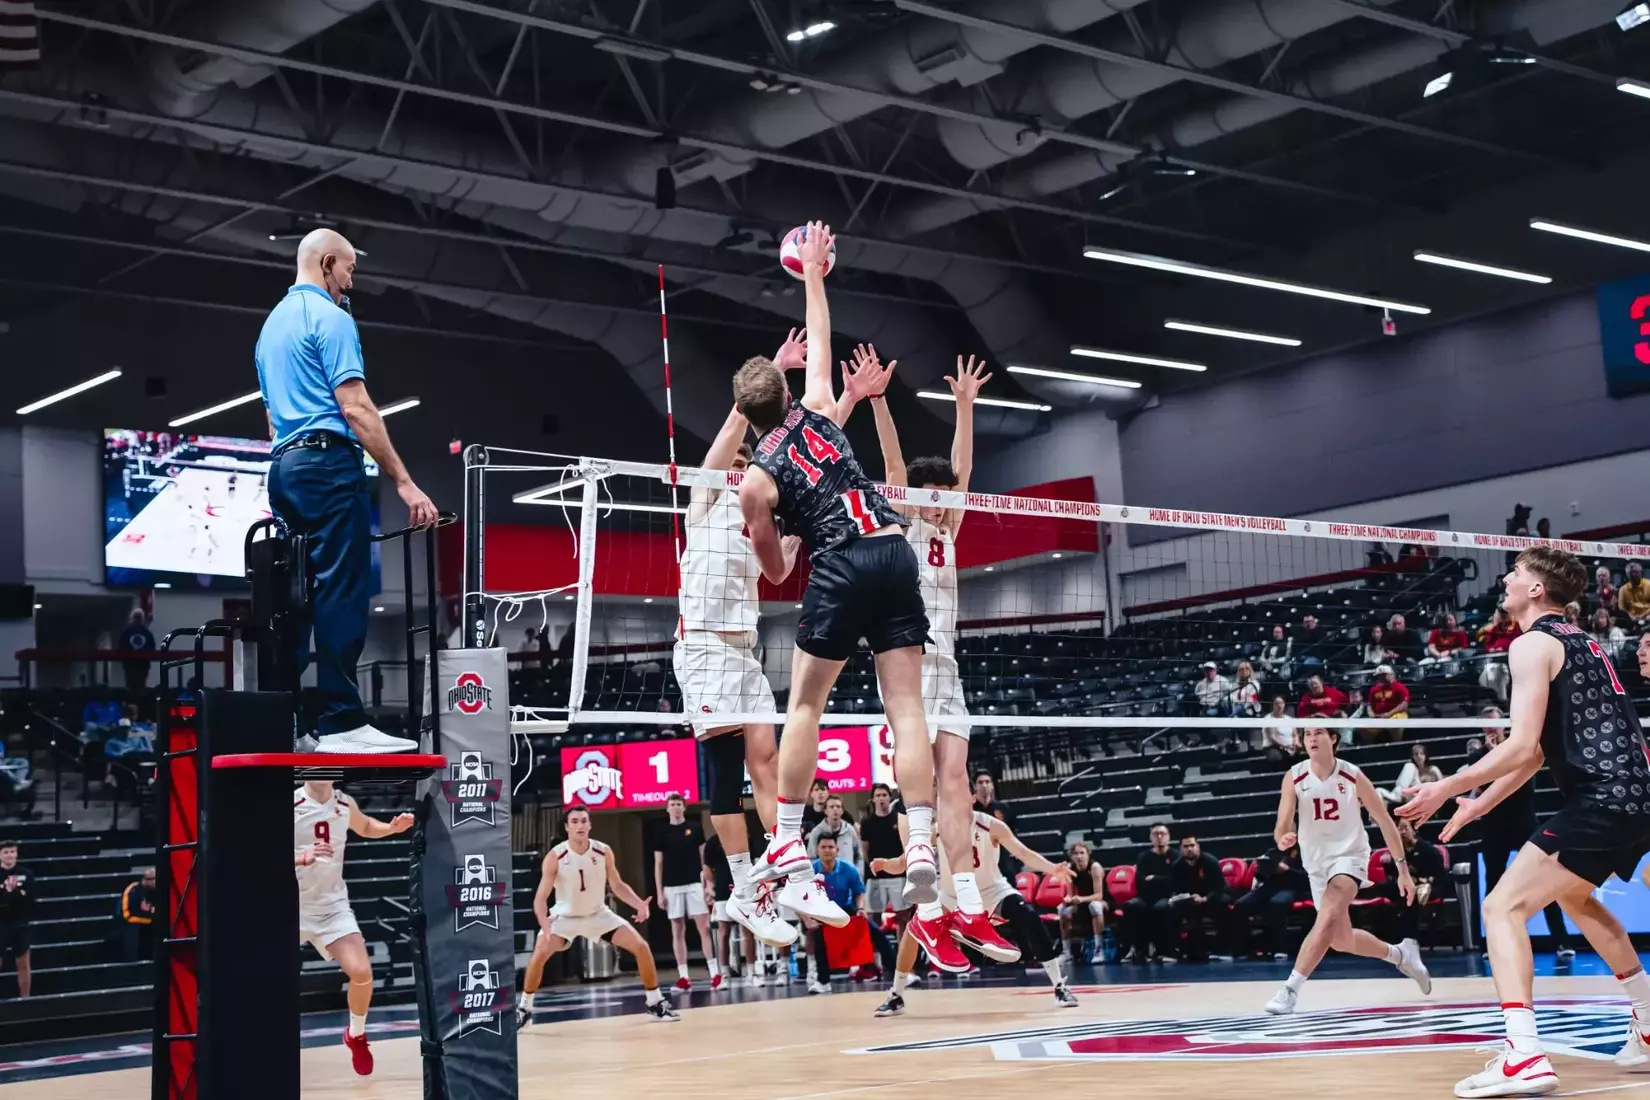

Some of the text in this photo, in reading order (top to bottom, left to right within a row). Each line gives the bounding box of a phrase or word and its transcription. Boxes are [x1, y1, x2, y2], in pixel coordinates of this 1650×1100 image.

[760, 427, 789, 456] OHIO
[788, 425, 842, 487] 14
[964, 492, 1012, 509] THREE-TIME
[1013, 496, 1053, 513] NATIONAL
[1055, 500, 1101, 516] CHAMPIONS
[1149, 509, 1287, 531] HOME OF OHIO STATE MEN'S VOLLEYBALL
[1328, 523, 1436, 541] THREE-TIME NATIONAL CHAMPIONS
[928, 537, 945, 568] 8
[1586, 640, 1625, 695] 7
[817, 738, 852, 772] 3
[649, 751, 669, 783] 1
[458, 783, 487, 798] 2011
[859, 777, 867, 787] 2
[684, 789, 691, 799] 2
[1313, 798, 1340, 821] 12
[314, 821, 330, 846] 9
[578, 869, 586, 892] 1
[460, 886, 492, 901] 2016
[464, 992, 495, 1008] 2017
